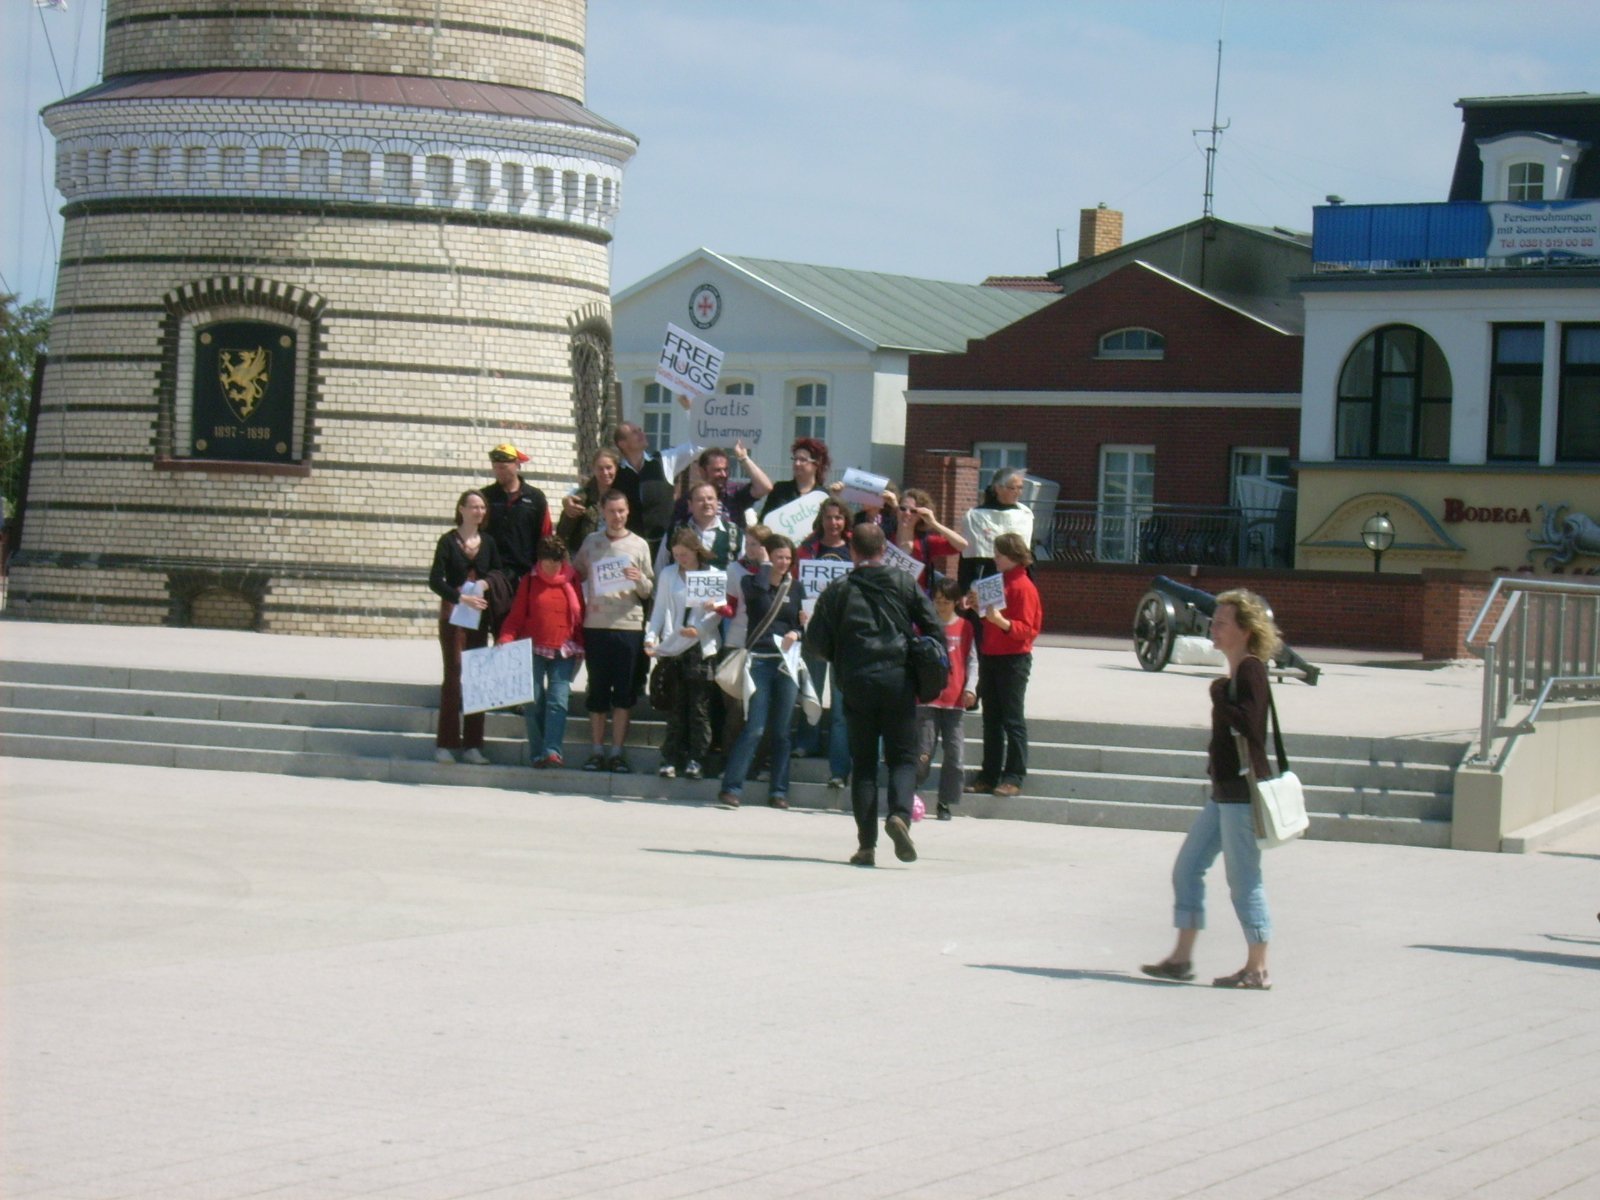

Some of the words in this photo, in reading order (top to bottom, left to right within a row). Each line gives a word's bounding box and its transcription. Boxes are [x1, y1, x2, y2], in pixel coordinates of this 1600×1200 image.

[1503, 212, 1592, 223] Ferienwohnungen
[1497, 226, 1513, 235] mit
[1516, 225, 1597, 234] Sonnenterrasse
[1501, 239, 1517, 249] Tel.
[664, 331, 721, 375] FREE
[660, 348, 716, 391] HUGS
[704, 398, 750, 416] Gratis
[214, 426, 237, 438] 1897
[697, 420, 762, 444] Umarmung
[1443, 498, 1531, 523] BODEGA
[597, 559, 623, 573] FREE
[598, 570, 624, 582] HUG
[688, 576, 724, 587] FREE
[687, 586, 725, 598] HUGS
[802, 580, 830, 593] HU
